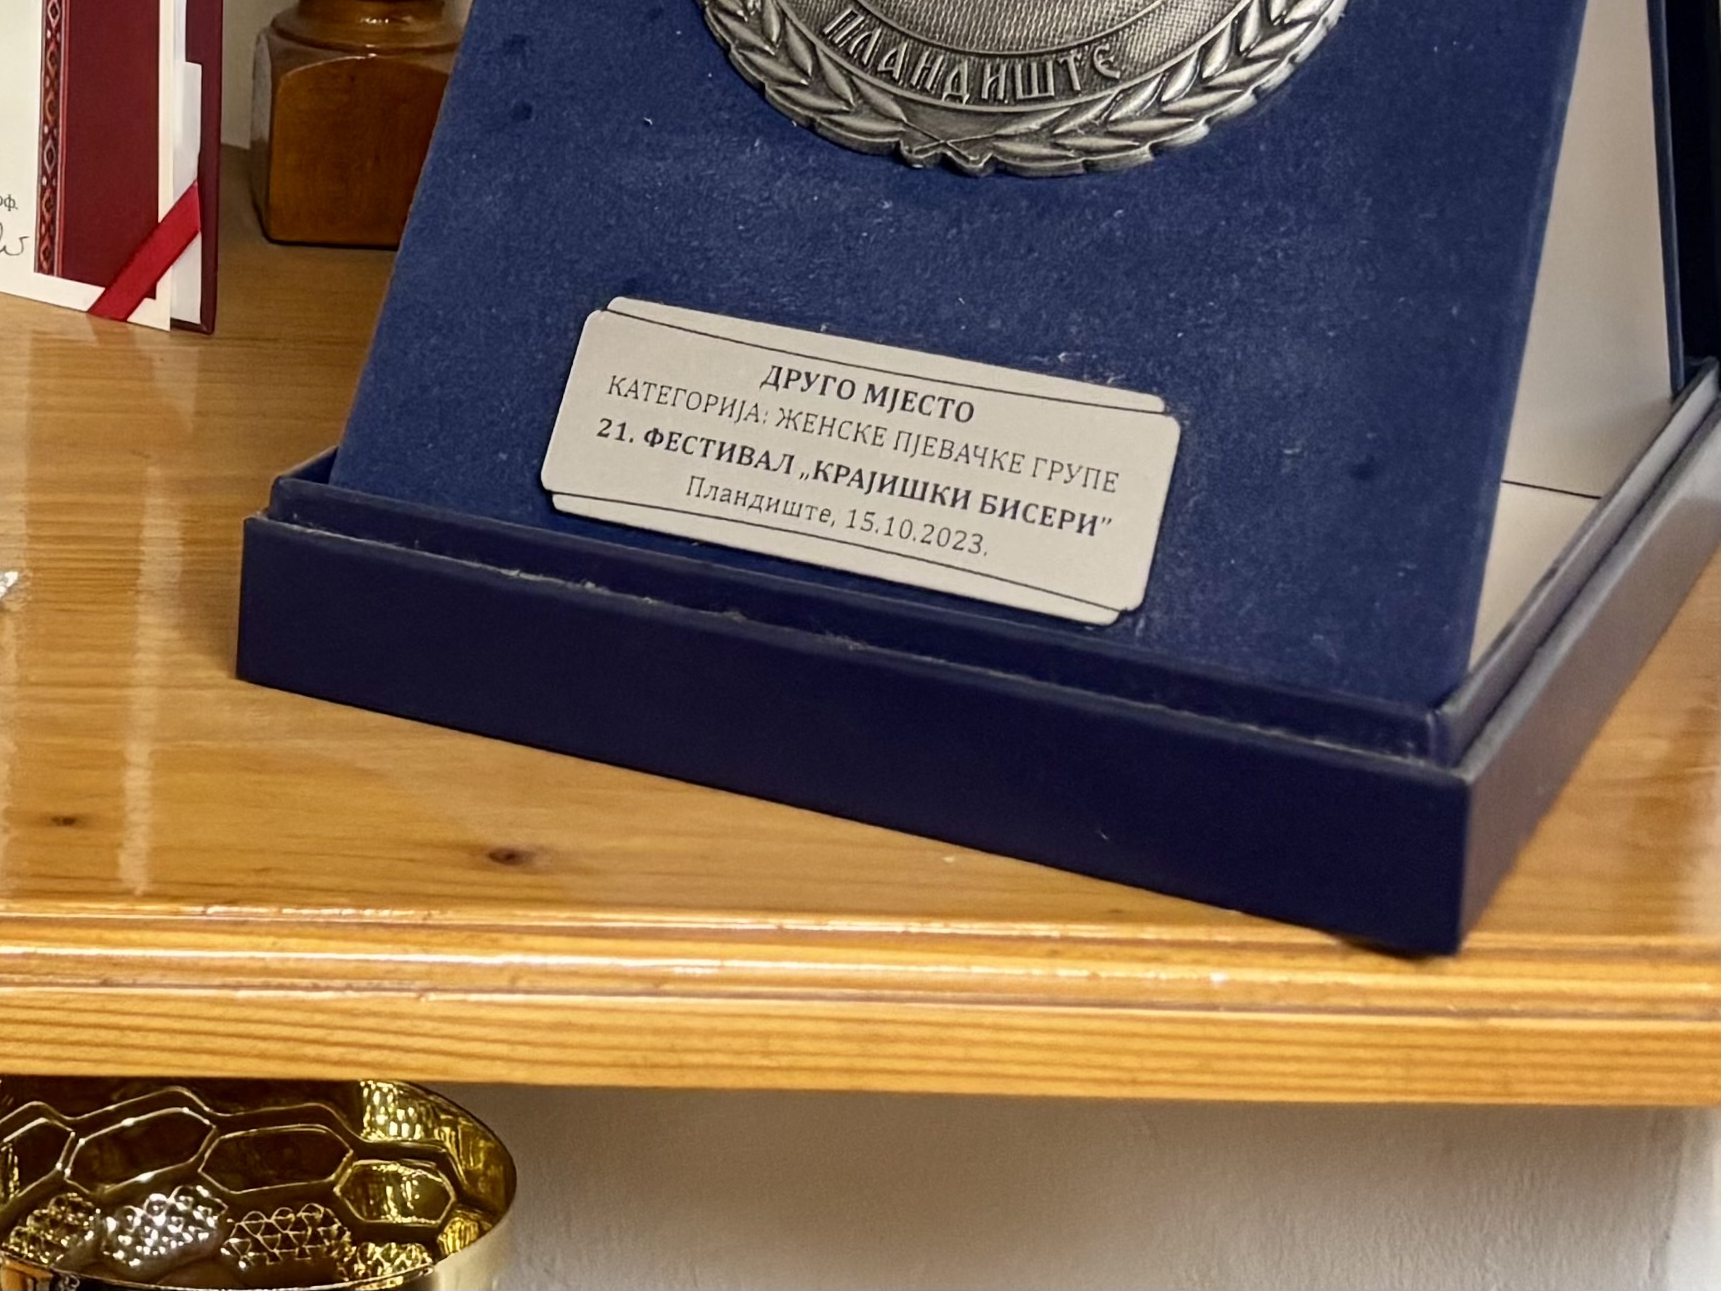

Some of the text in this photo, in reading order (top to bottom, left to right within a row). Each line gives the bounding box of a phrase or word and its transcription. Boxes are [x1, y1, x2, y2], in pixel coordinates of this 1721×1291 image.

[820, 6, 1121, 104] ПЛАНДИШТЕ
[607, 374, 1119, 493] КАТЕГОРИЈА: ЖЕНСКЕ ПЈЕВАЧКЕ ГРУПЕ
[760, 364, 975, 424] ДРУГО МЈЕСТО
[596, 417, 637, 446] 21.
[642, 425, 794, 475] ФЕСТИВАЛ
[798, 457, 973, 511] „КРАЈИШКИ
[686, 476, 991, 558] Пландиште, 15.10.2023.
